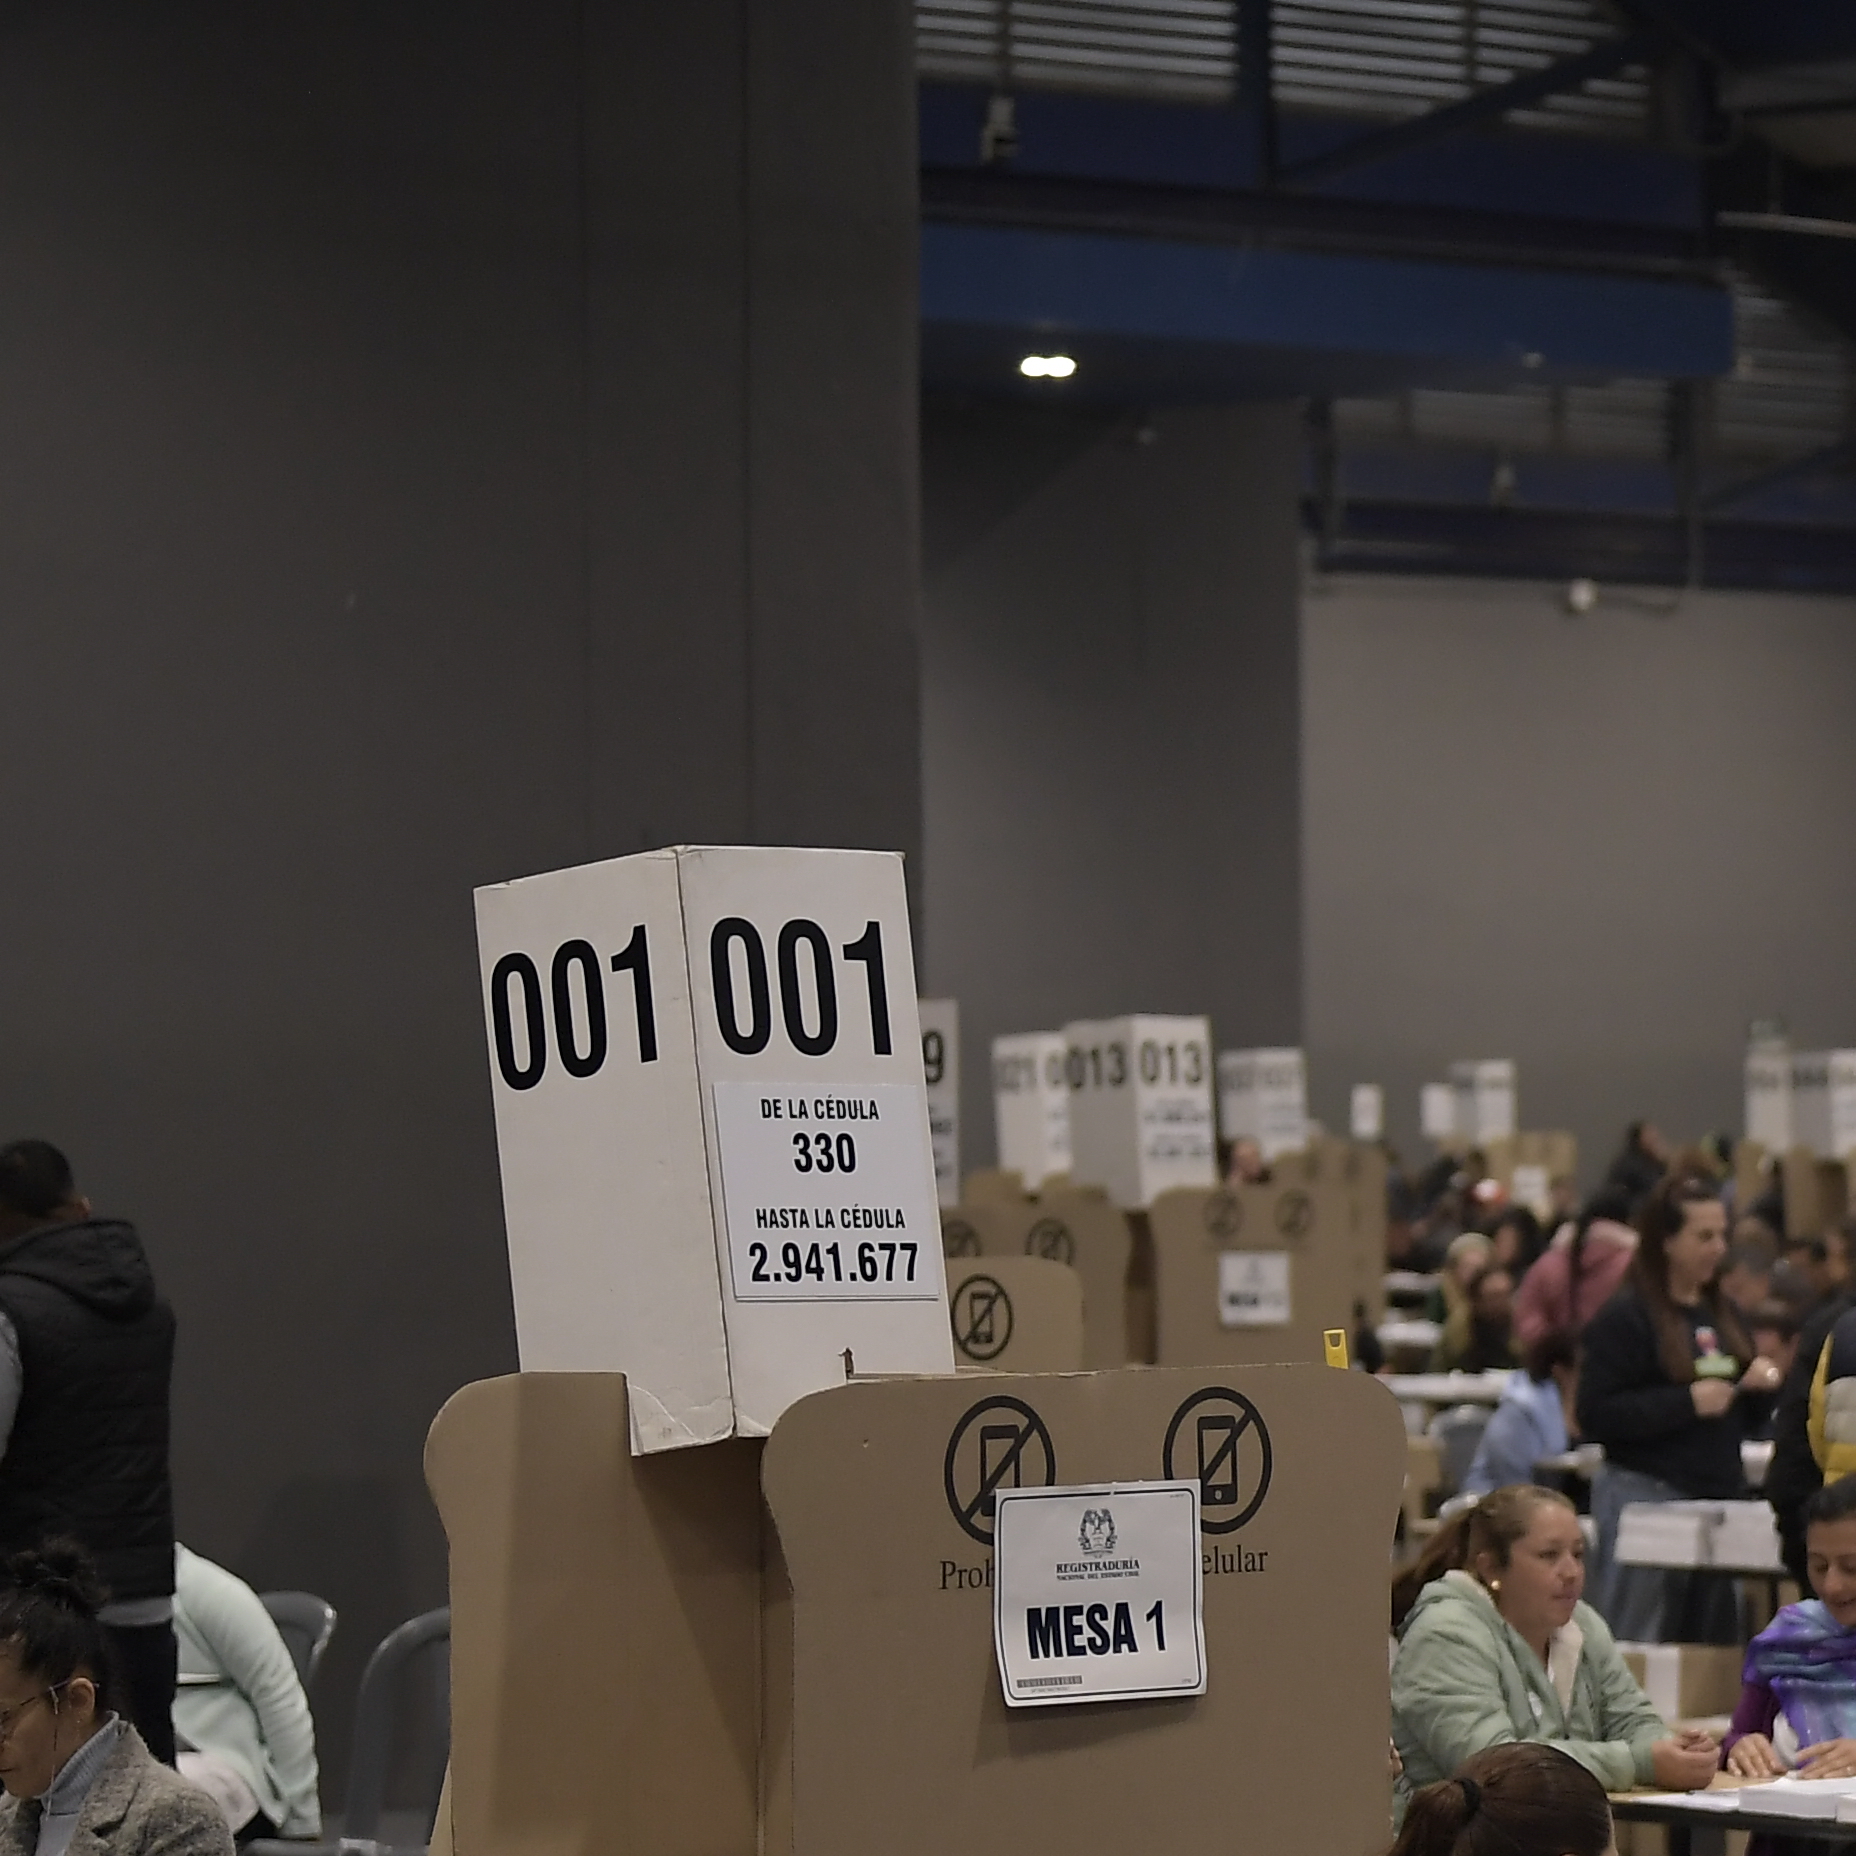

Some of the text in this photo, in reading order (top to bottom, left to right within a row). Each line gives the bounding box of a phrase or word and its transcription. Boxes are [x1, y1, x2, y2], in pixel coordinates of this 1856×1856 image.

[710, 917, 892, 1055] 001
[491, 924, 658, 1091] 001
[1065, 1040, 1128, 1089] 013
[1139, 1038, 1202, 1087] 013
[760, 1094, 880, 1121] DE LA CÉDULA
[791, 1132, 858, 1174] 330
[755, 1204, 906, 1230] HASTA LA CÉDULA
[748, 1242, 919, 1283] 2.941.677
[1056, 1556, 1140, 1574] REGISTRADURÍA
[1202, 1545, 1269, 1576] elular
[1027, 1600, 1166, 1659] MESA 1
